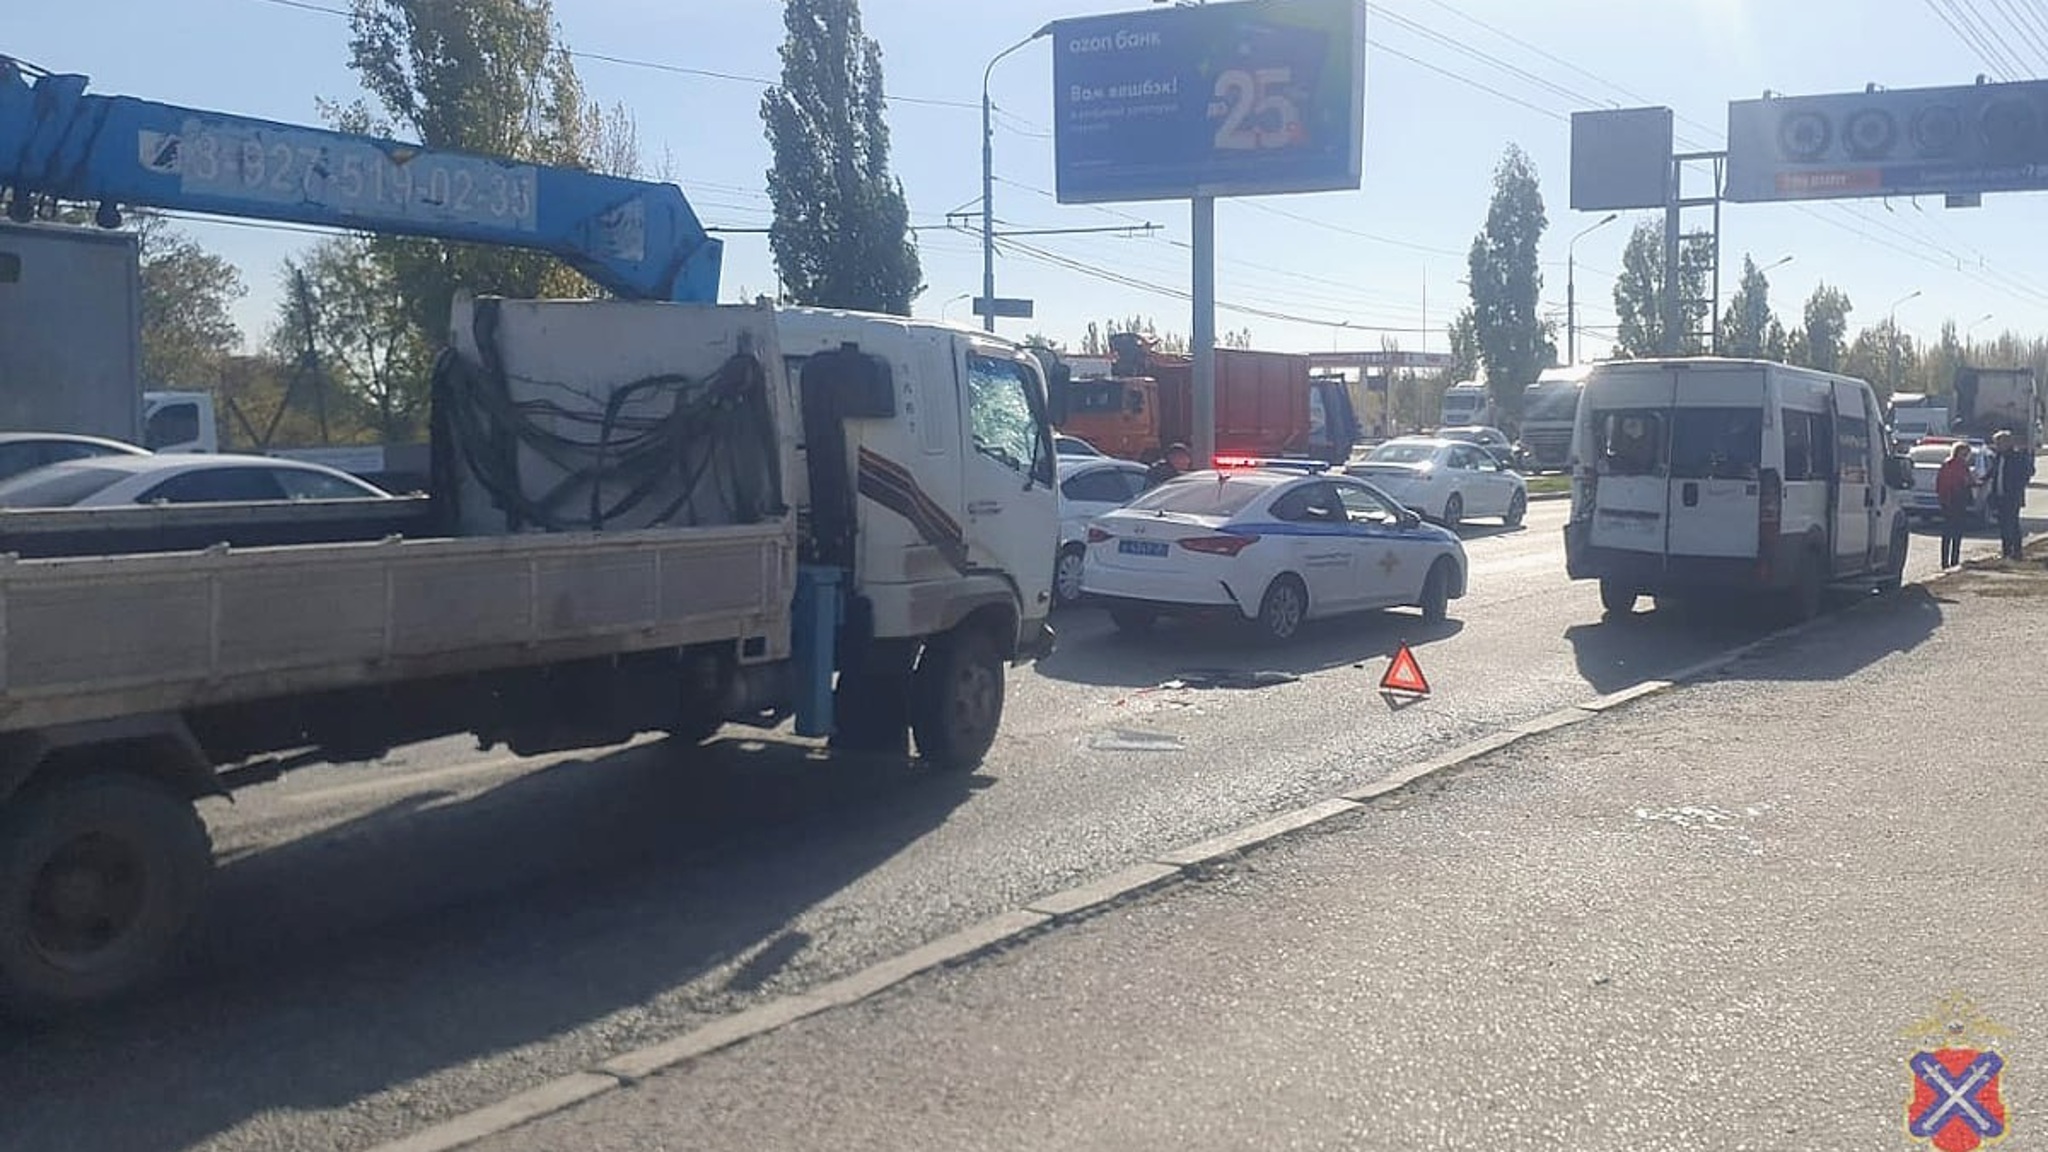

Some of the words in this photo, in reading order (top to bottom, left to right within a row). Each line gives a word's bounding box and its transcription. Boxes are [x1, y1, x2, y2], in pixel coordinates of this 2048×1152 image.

[1069, 36, 1112, 53] ozon
[1115, 30, 1161, 49] банк
[1214, 67, 1300, 149] 25
